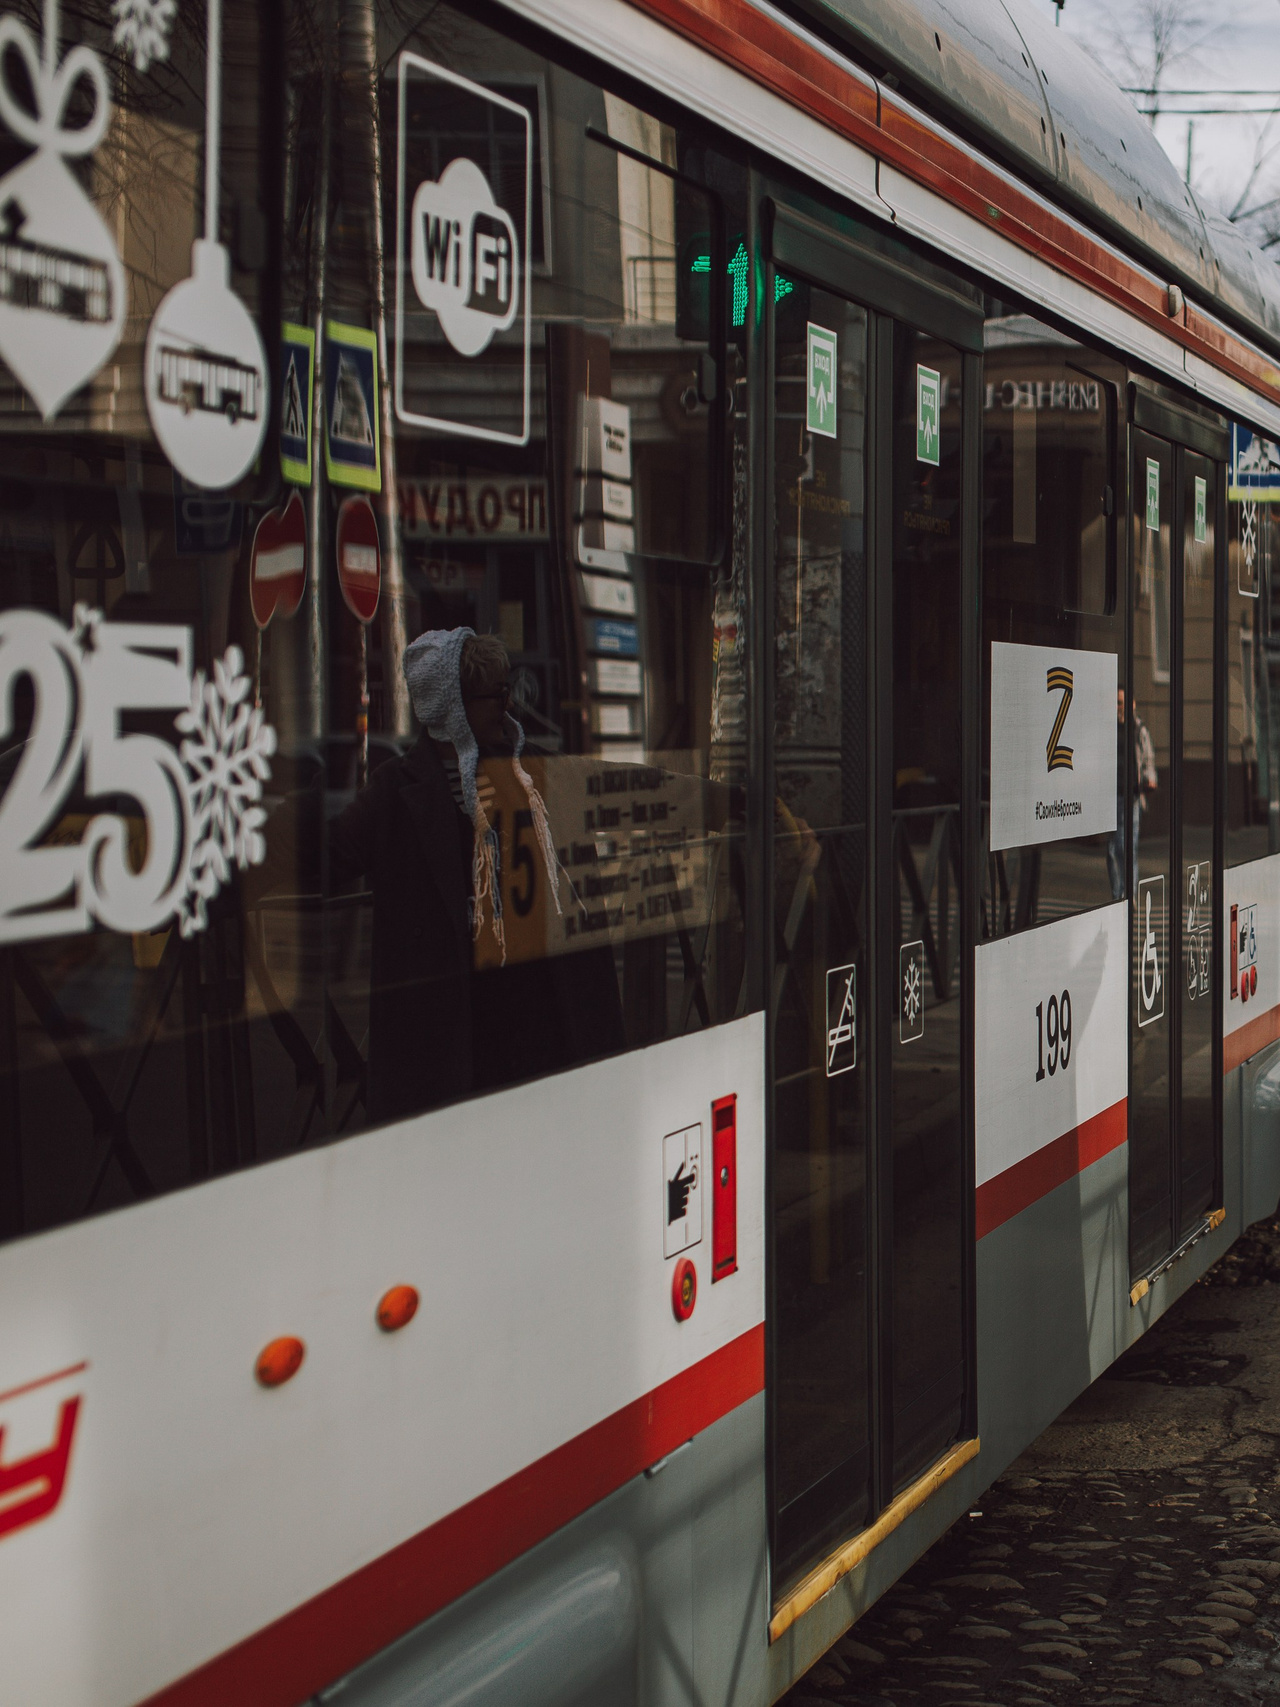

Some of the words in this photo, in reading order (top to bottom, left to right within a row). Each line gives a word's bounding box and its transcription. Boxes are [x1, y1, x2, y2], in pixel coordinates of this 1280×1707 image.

[814, 352, 830, 376] ВХОД
[922, 390, 935, 411] ВХОД
[1046, 666, 1074, 773] Z
[1036, 989, 1072, 1082] 199
